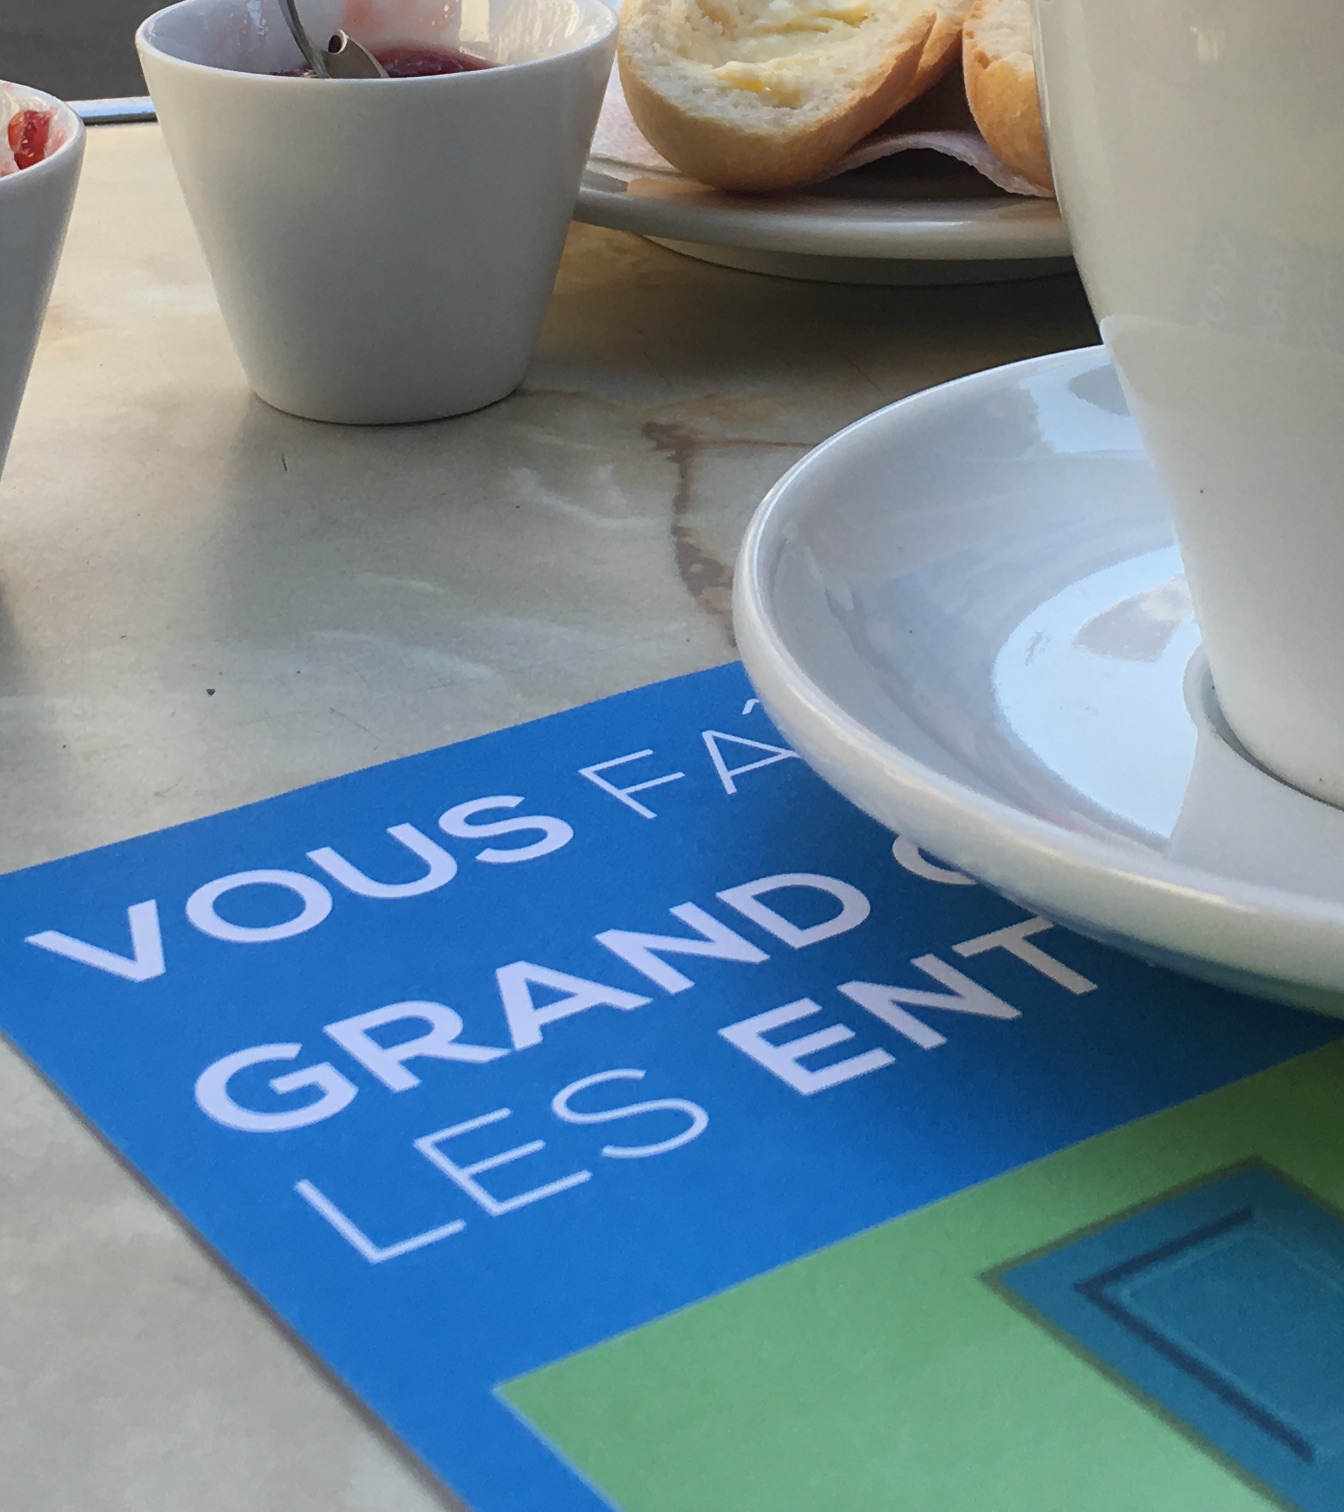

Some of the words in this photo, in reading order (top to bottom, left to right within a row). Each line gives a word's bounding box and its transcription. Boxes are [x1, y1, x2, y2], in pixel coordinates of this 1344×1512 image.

[23, 794, 574, 983] VOUS
[577, 699, 801, 820] FA
[194, 872, 872, 1133] GRAND
[296, 1068, 709, 1264] LES
[716, 915, 1099, 1096] ENT
